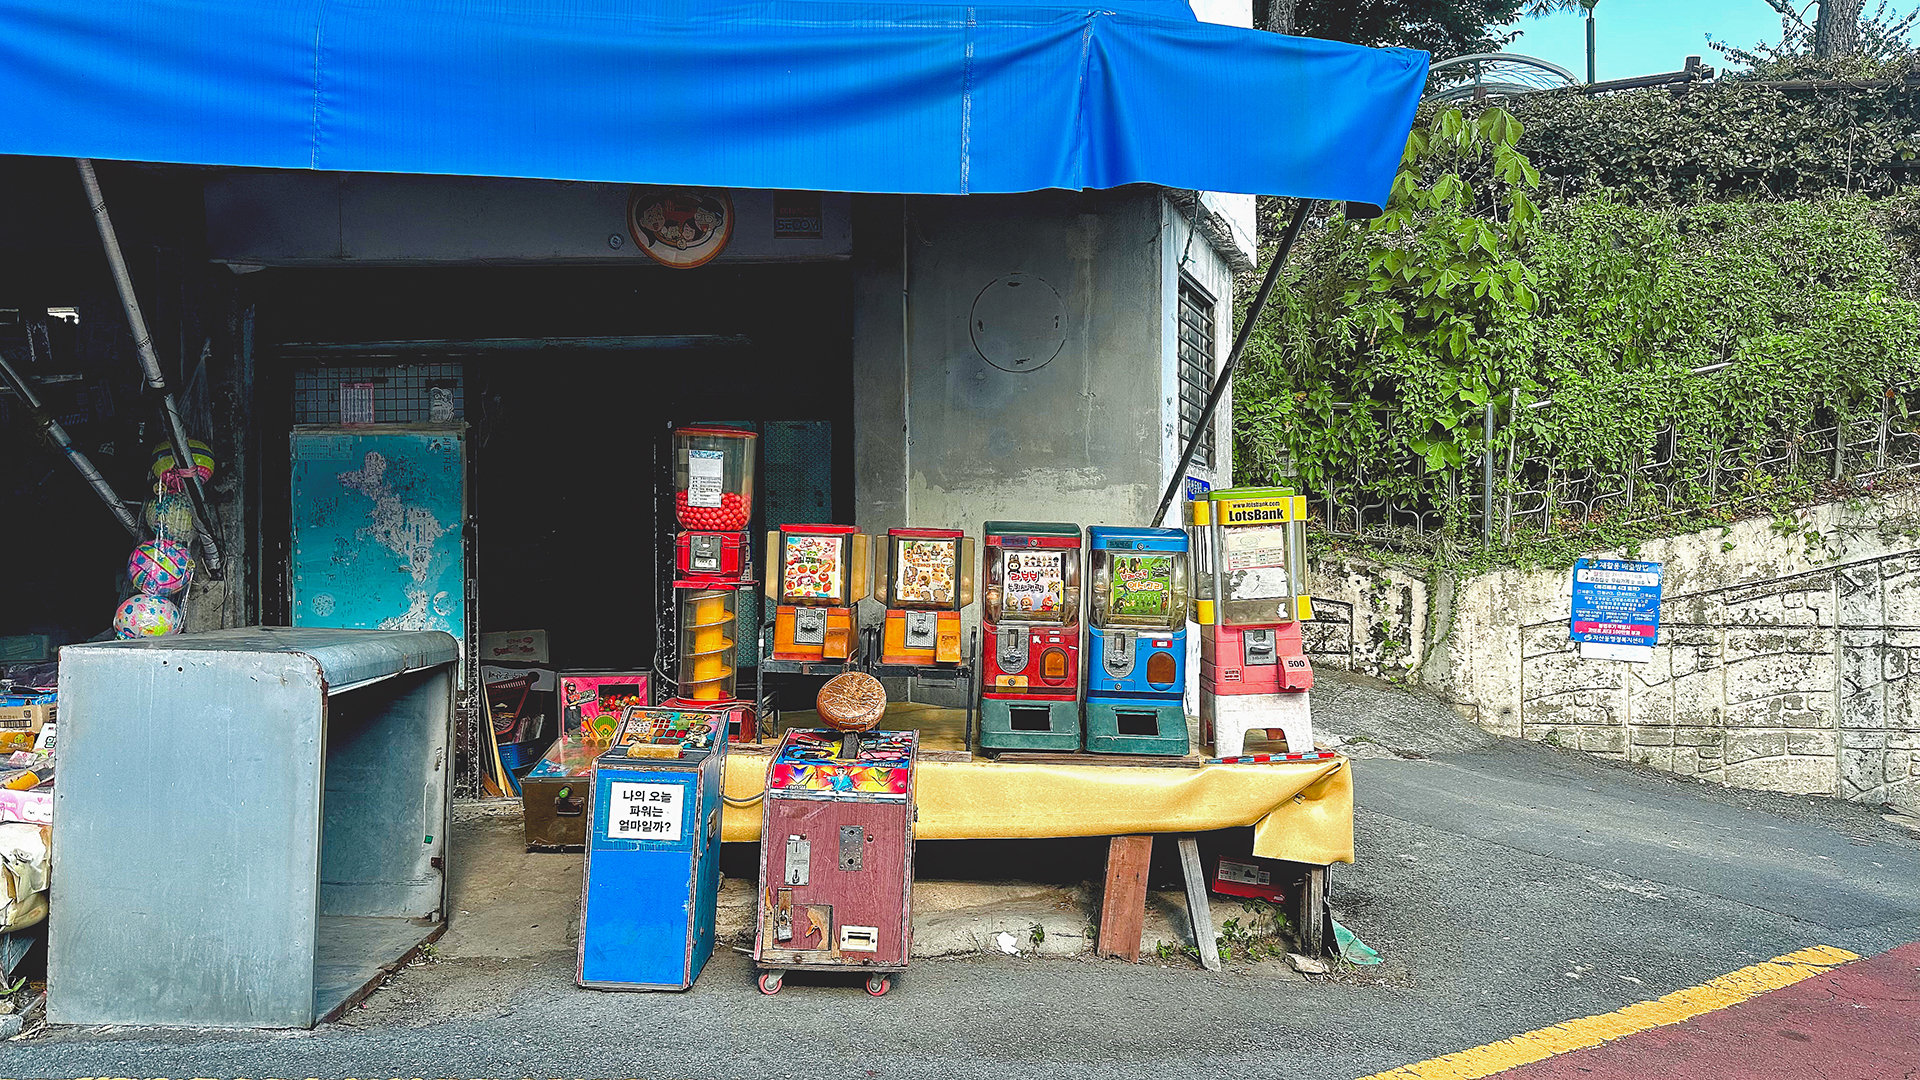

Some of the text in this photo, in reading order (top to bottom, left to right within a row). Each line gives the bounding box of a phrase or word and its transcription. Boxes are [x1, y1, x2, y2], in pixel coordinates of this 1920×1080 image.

[777, 218, 820, 231] SECOM
[1232, 500, 1281, 509] www.lotsbank.com
[1228, 507, 1284, 522] LotsBank
[1599, 561, 1649, 572] 재활용 배출방법
[1010, 570, 1039, 582] 라부부
[1592, 634, 1644, 644] 자산동행정복지센터
[1287, 659, 1305, 668] 500
[622, 790, 672, 803] 나의 오늘
[629, 805, 663, 817] 파워는
[619, 820, 672, 833] 얼마일까?
